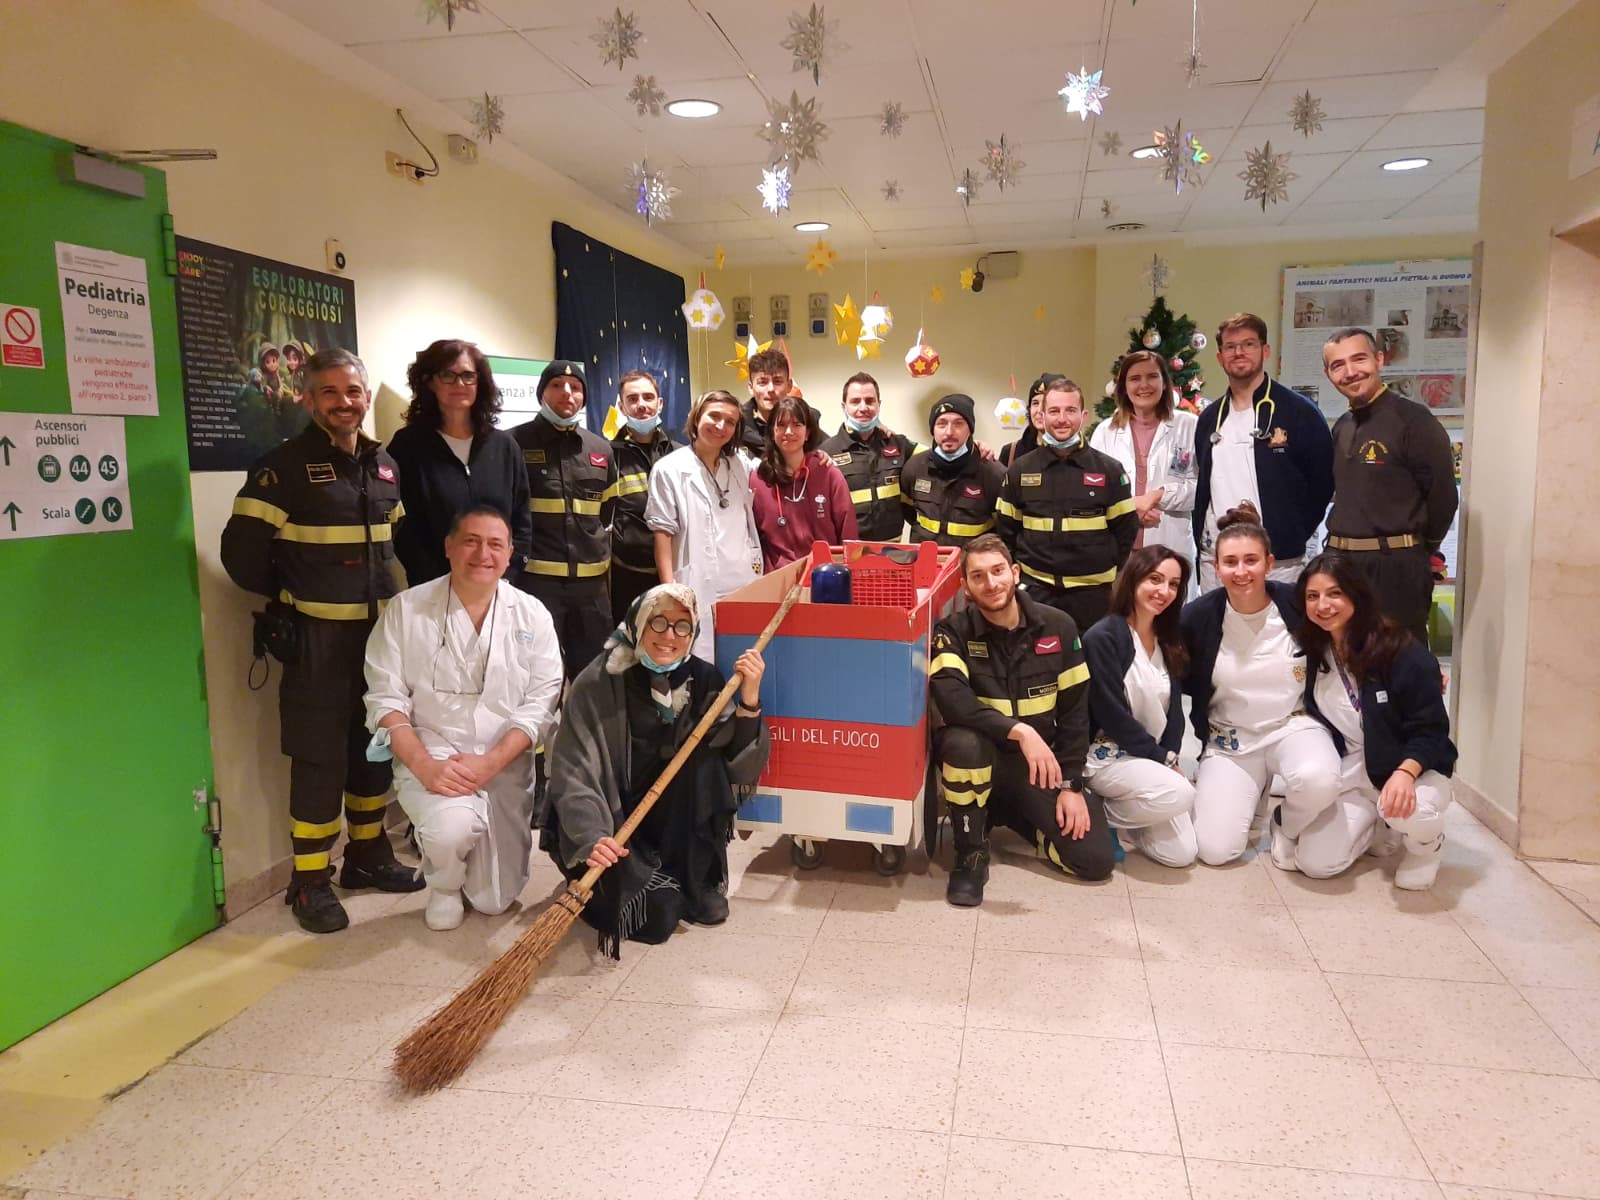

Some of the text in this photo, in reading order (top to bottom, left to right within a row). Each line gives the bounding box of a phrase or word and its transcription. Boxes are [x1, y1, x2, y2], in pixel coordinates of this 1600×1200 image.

[252, 266, 344, 305] ESPLORATORI
[1328, 277, 1373, 285] FANTASTICI
[65, 277, 146, 306] Pediatria
[88, 303, 129, 319] Degenza
[259, 290, 342, 324] CORAGGIOSI
[35, 419, 87, 432] Ascensori
[36, 434, 80, 447] pubblici
[71, 461, 117, 475] 44 45
[42, 502, 117, 520] Scala K
[801, 728, 829, 745] DEL
[833, 729, 880, 749] FUOCO
